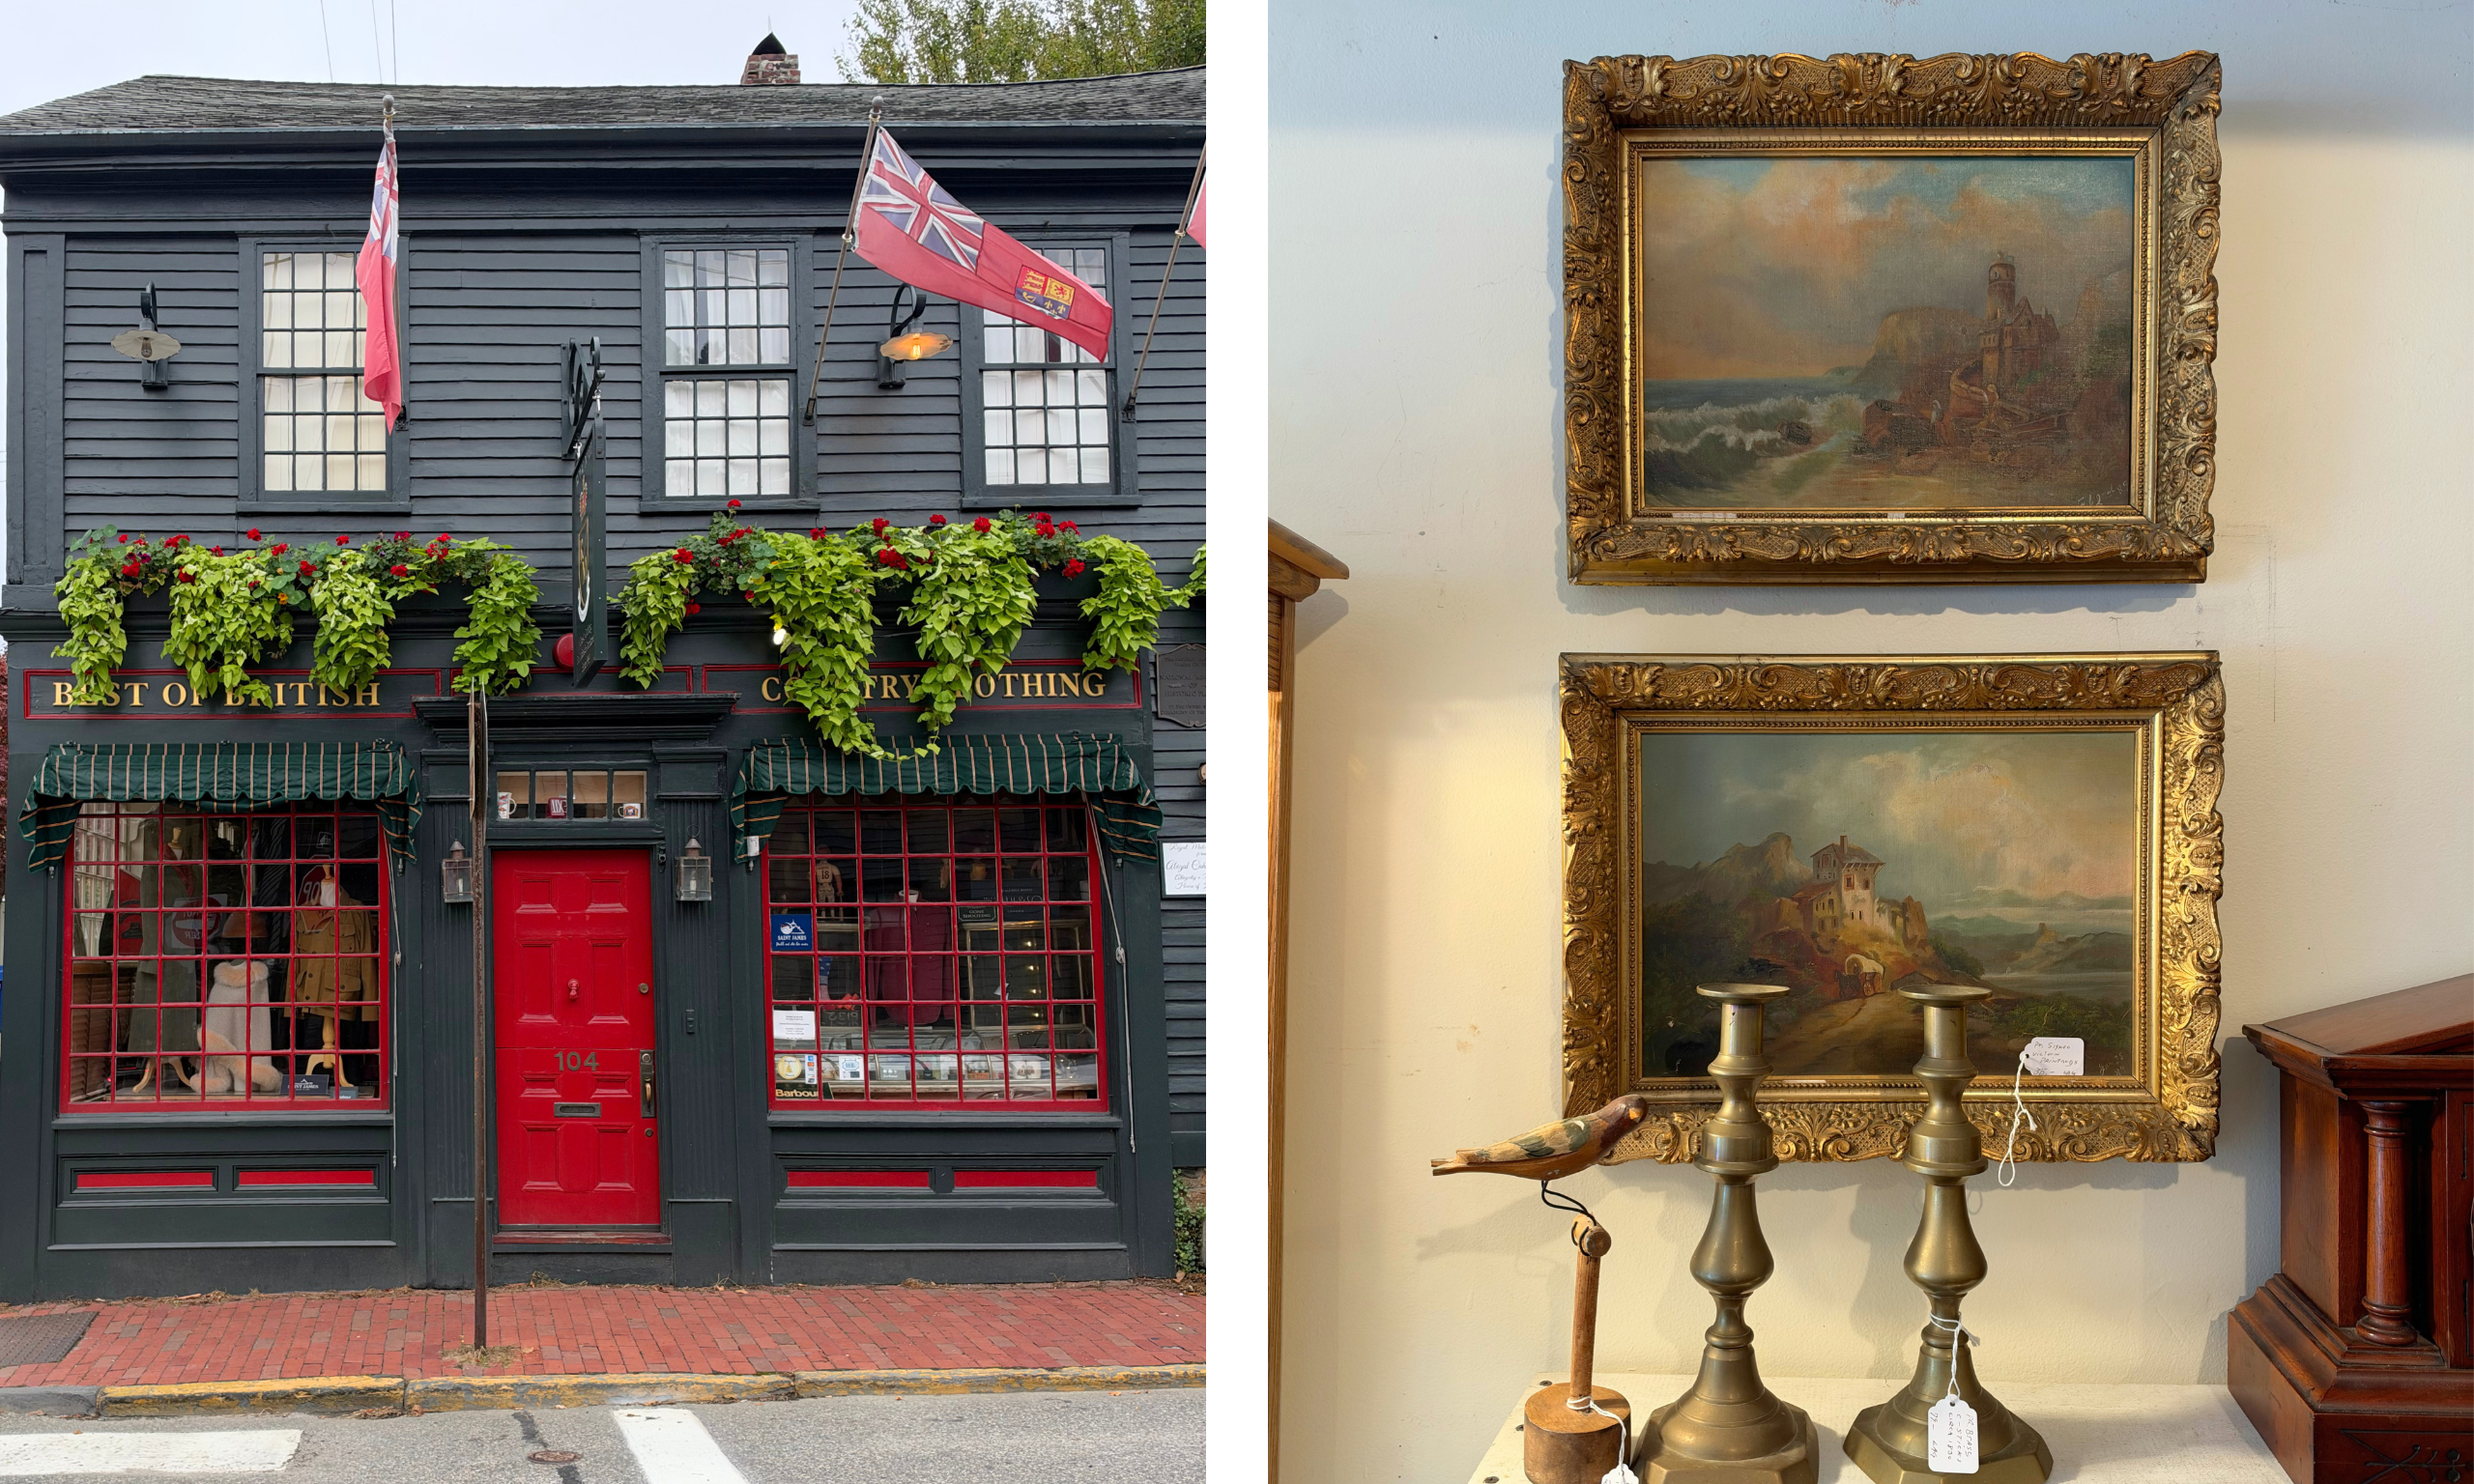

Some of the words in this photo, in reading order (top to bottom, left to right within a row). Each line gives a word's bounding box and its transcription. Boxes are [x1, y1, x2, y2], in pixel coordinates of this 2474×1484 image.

[762, 675, 920, 701] CTRY
[930, 672, 1107, 698] OTHING
[554, 1051, 599, 1071] 104
